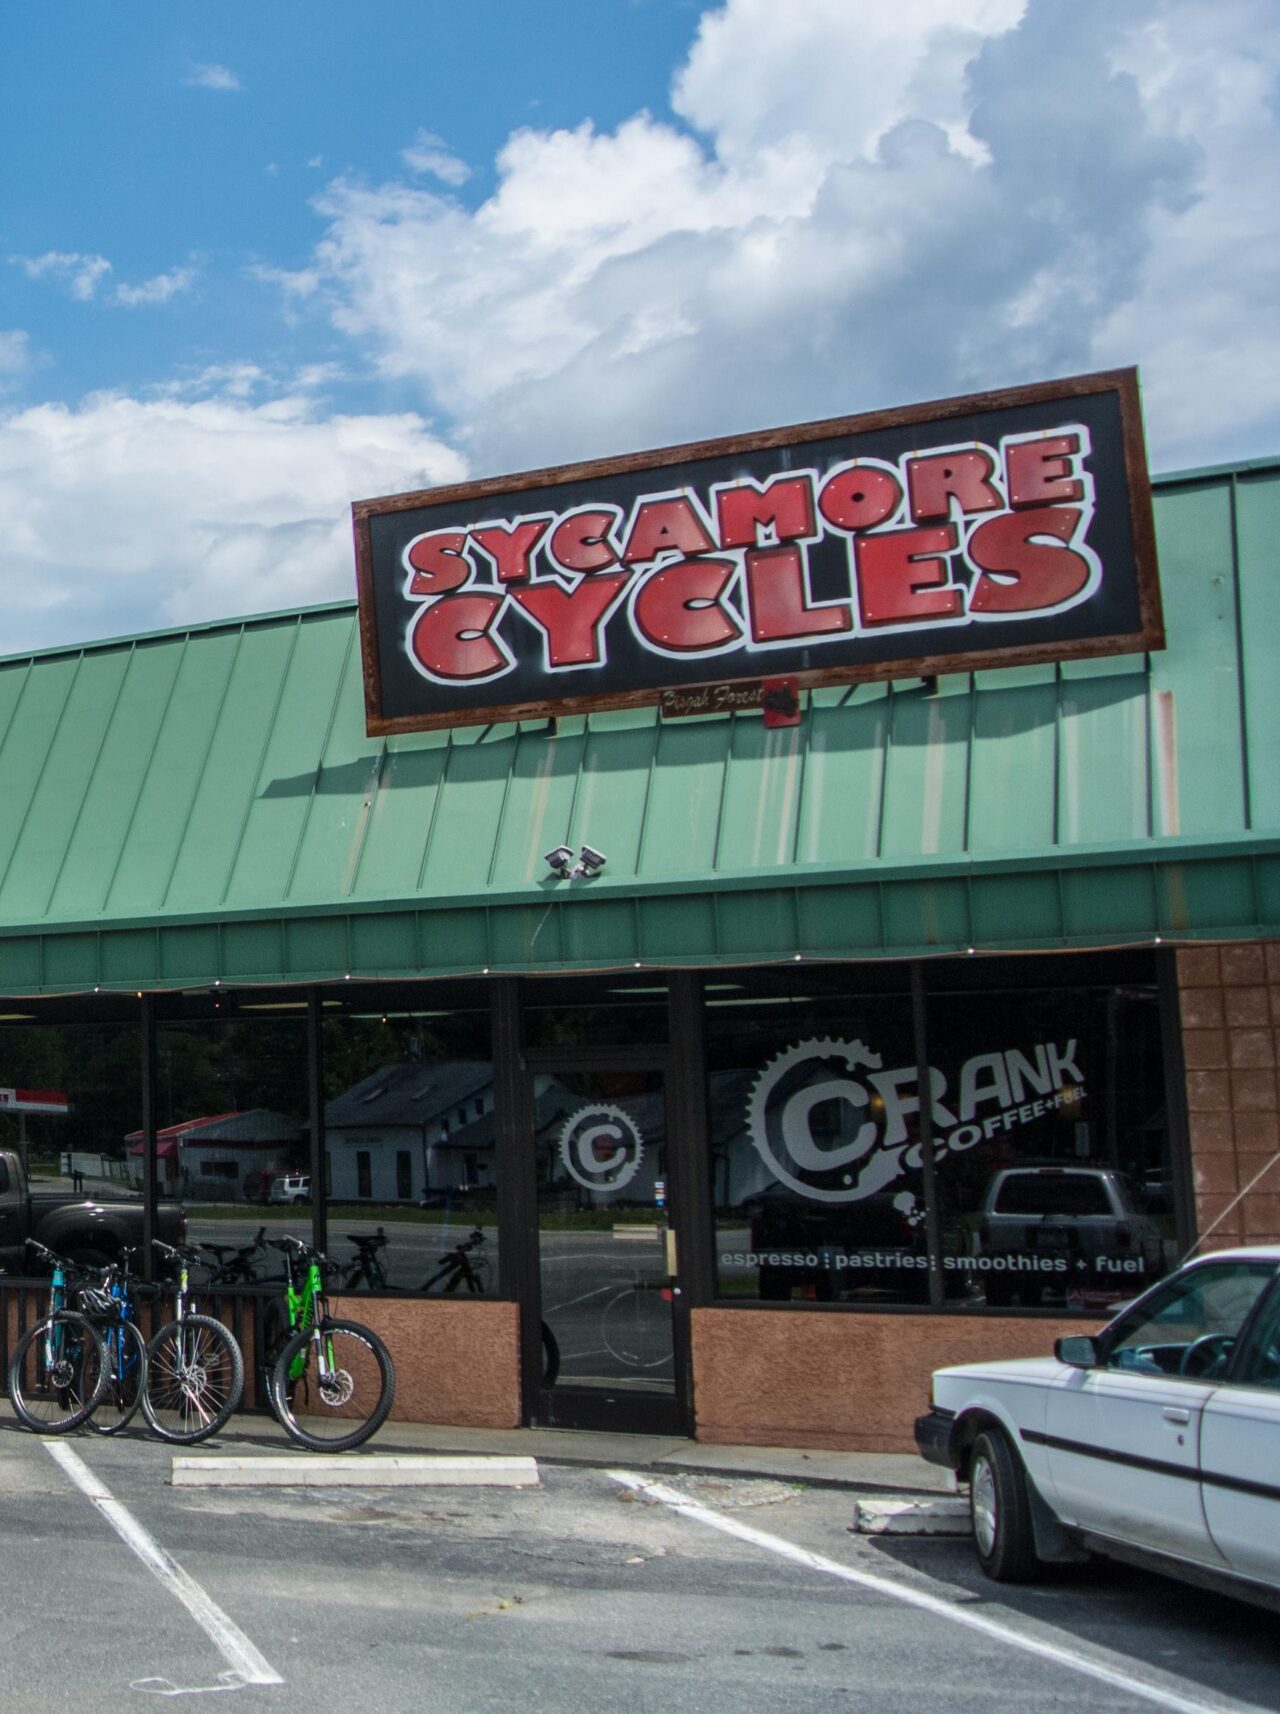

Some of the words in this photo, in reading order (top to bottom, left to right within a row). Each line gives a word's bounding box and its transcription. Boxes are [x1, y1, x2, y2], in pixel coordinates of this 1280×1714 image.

[405, 427, 1090, 600] SYCAMORE
[408, 503, 1100, 683] CYCLES
[780, 1038, 1085, 1172] CRANK
[721, 1252, 818, 1267] espresso
[835, 1252, 928, 1269] pastries
[943, 1254, 1068, 1272] smoothies
[1095, 1255, 1145, 1273] fuel
